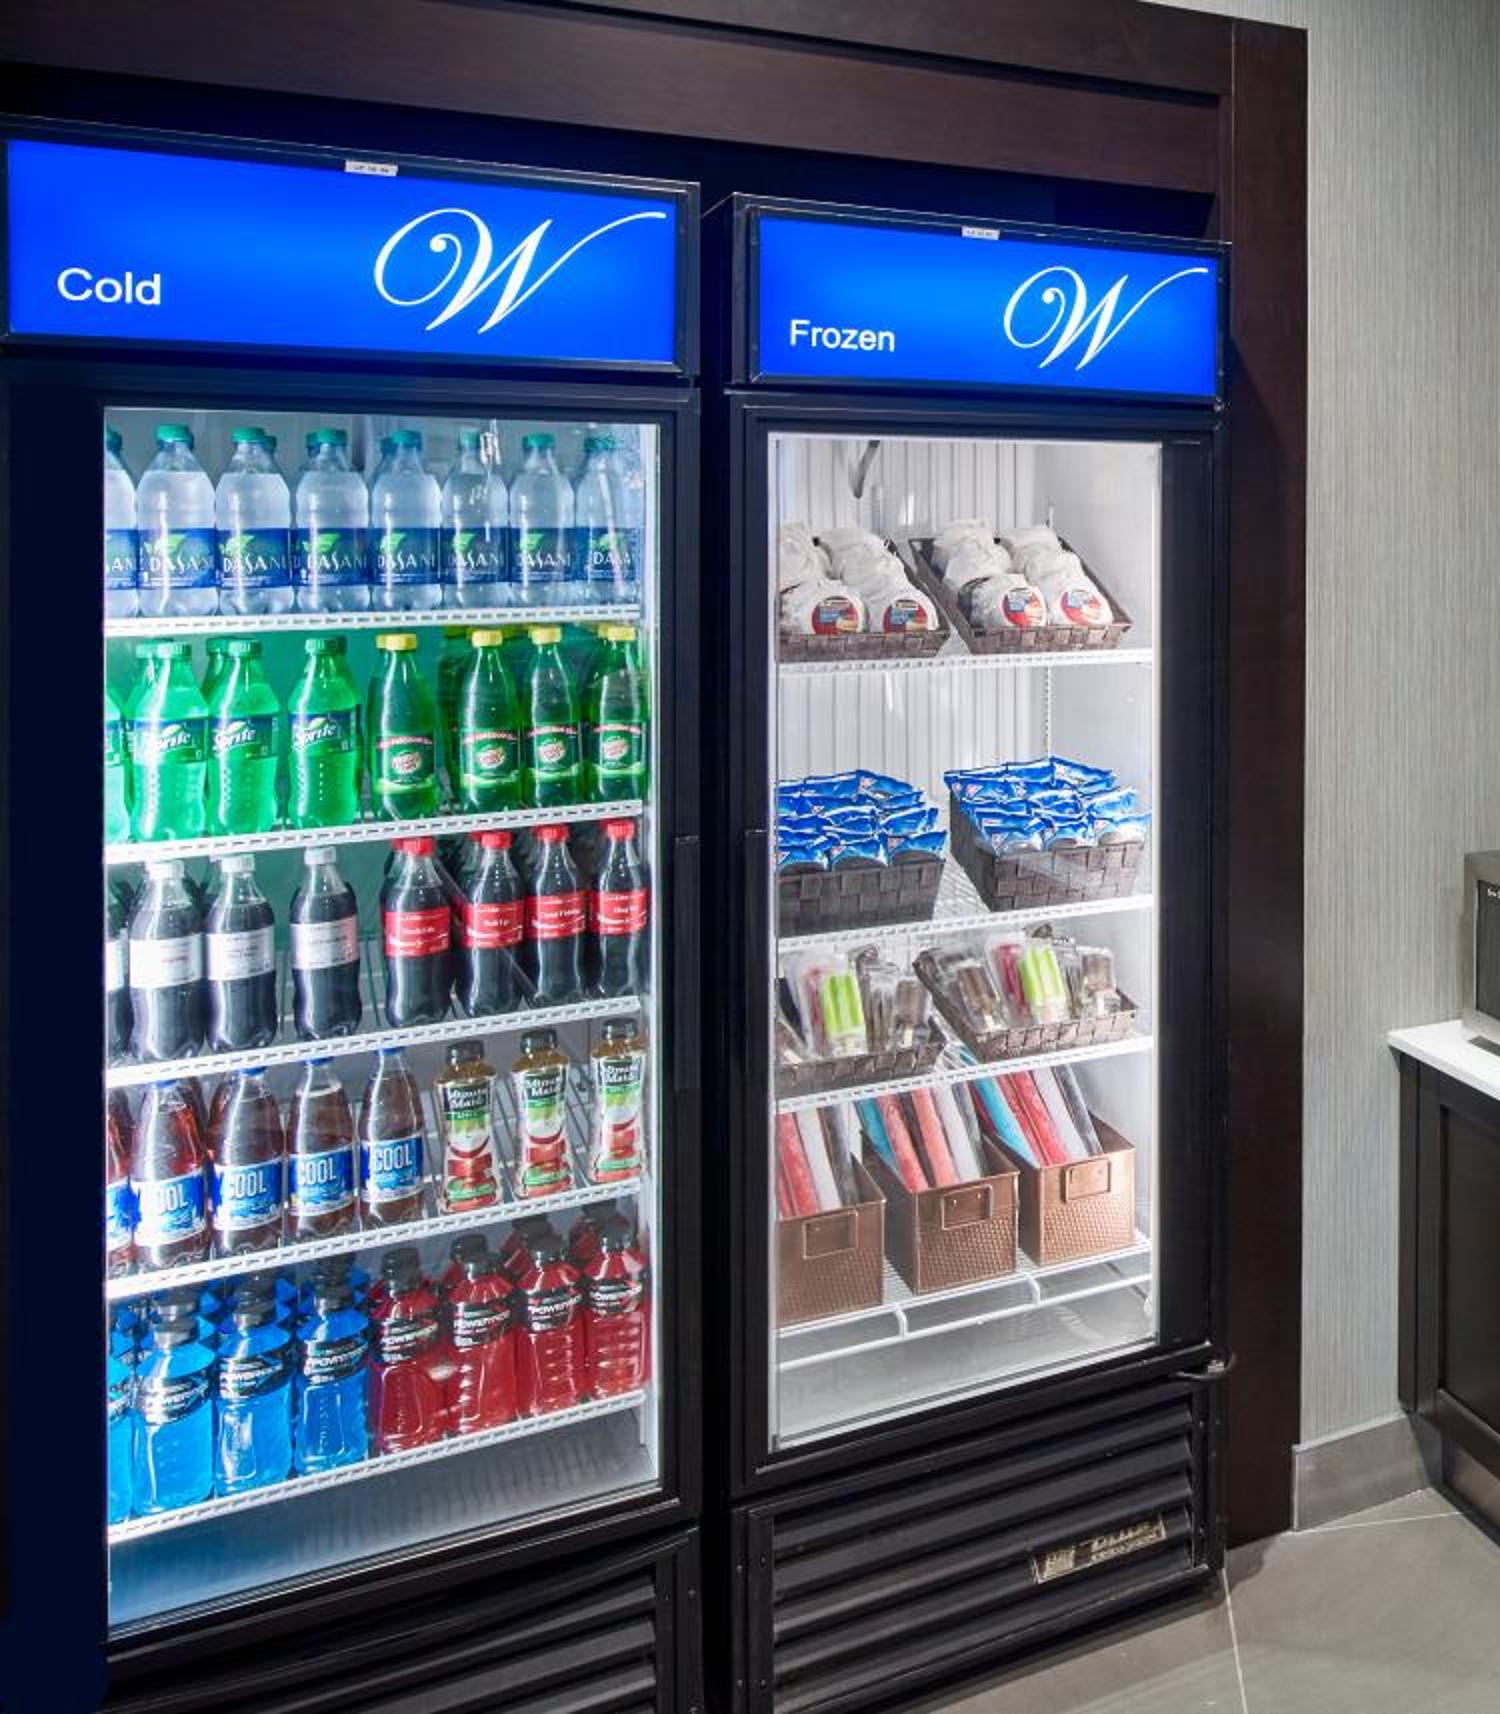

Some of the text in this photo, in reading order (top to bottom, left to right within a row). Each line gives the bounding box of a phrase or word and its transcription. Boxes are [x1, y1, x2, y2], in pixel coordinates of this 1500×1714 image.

[57, 267, 162, 305] Cold
[373, 207, 667, 334] W
[1003, 266, 1209, 370] W
[789, 319, 896, 352] Frozen
[150, 551, 213, 572] DASAN
[448, 552, 504, 569] ASANI
[373, 1144, 413, 1173] COOL
[156, 1184, 188, 1211] OOL
